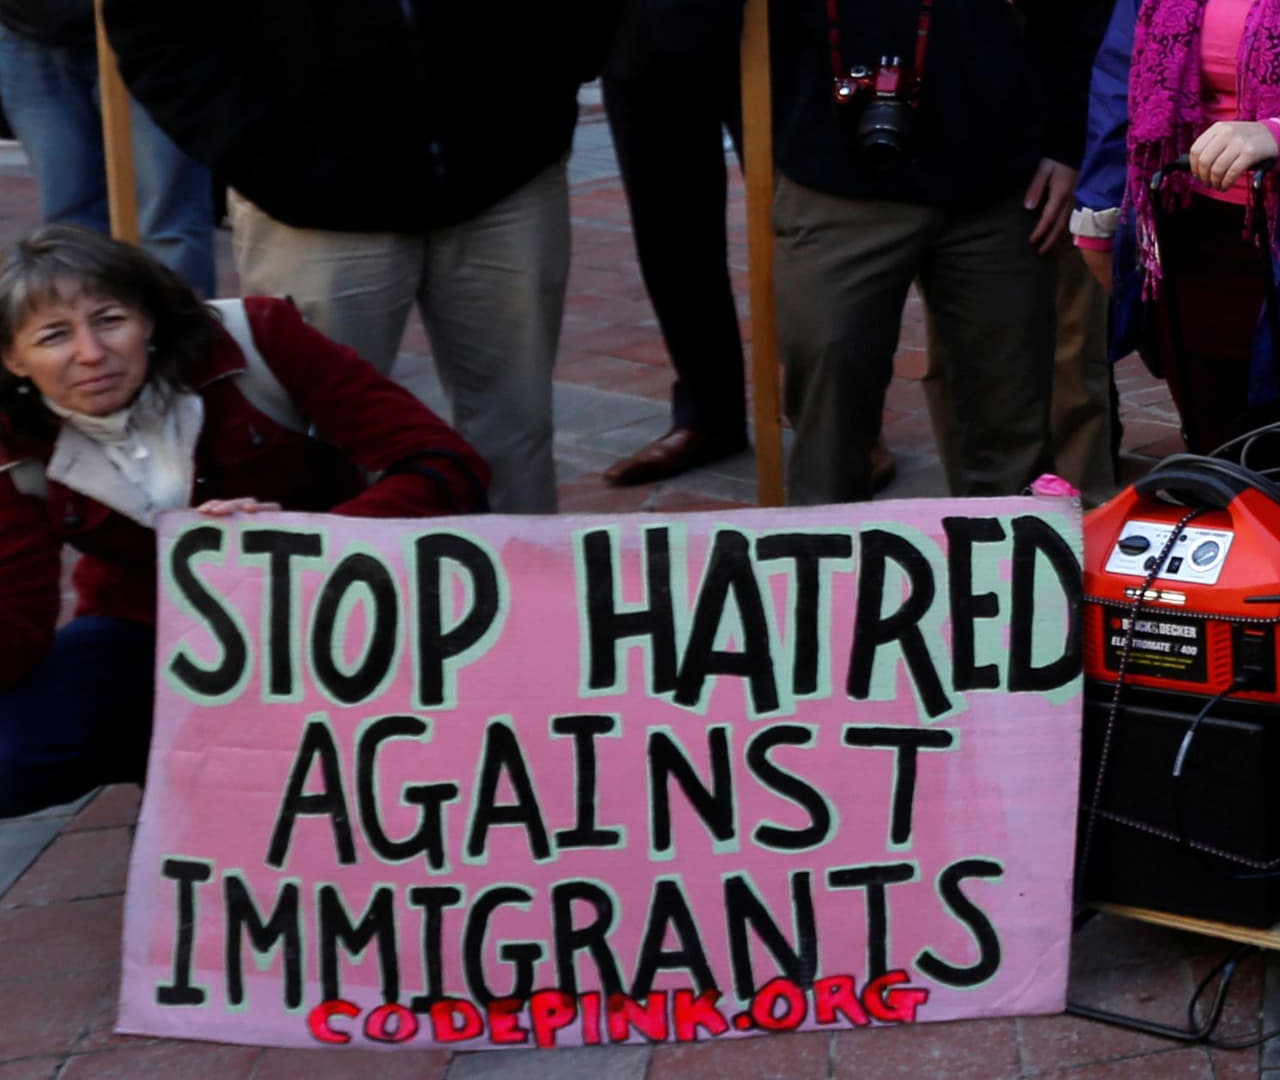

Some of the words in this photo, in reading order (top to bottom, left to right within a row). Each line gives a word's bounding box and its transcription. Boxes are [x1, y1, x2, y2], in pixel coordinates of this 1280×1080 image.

[170, 525, 500, 707] STOP
[576, 514, 1084, 720] HATRED
[266, 714, 954, 871] AGAINST
[156, 856, 1004, 1014] IMMIGRANTS
[304, 969, 929, 1052] CODEPINK.ORG
